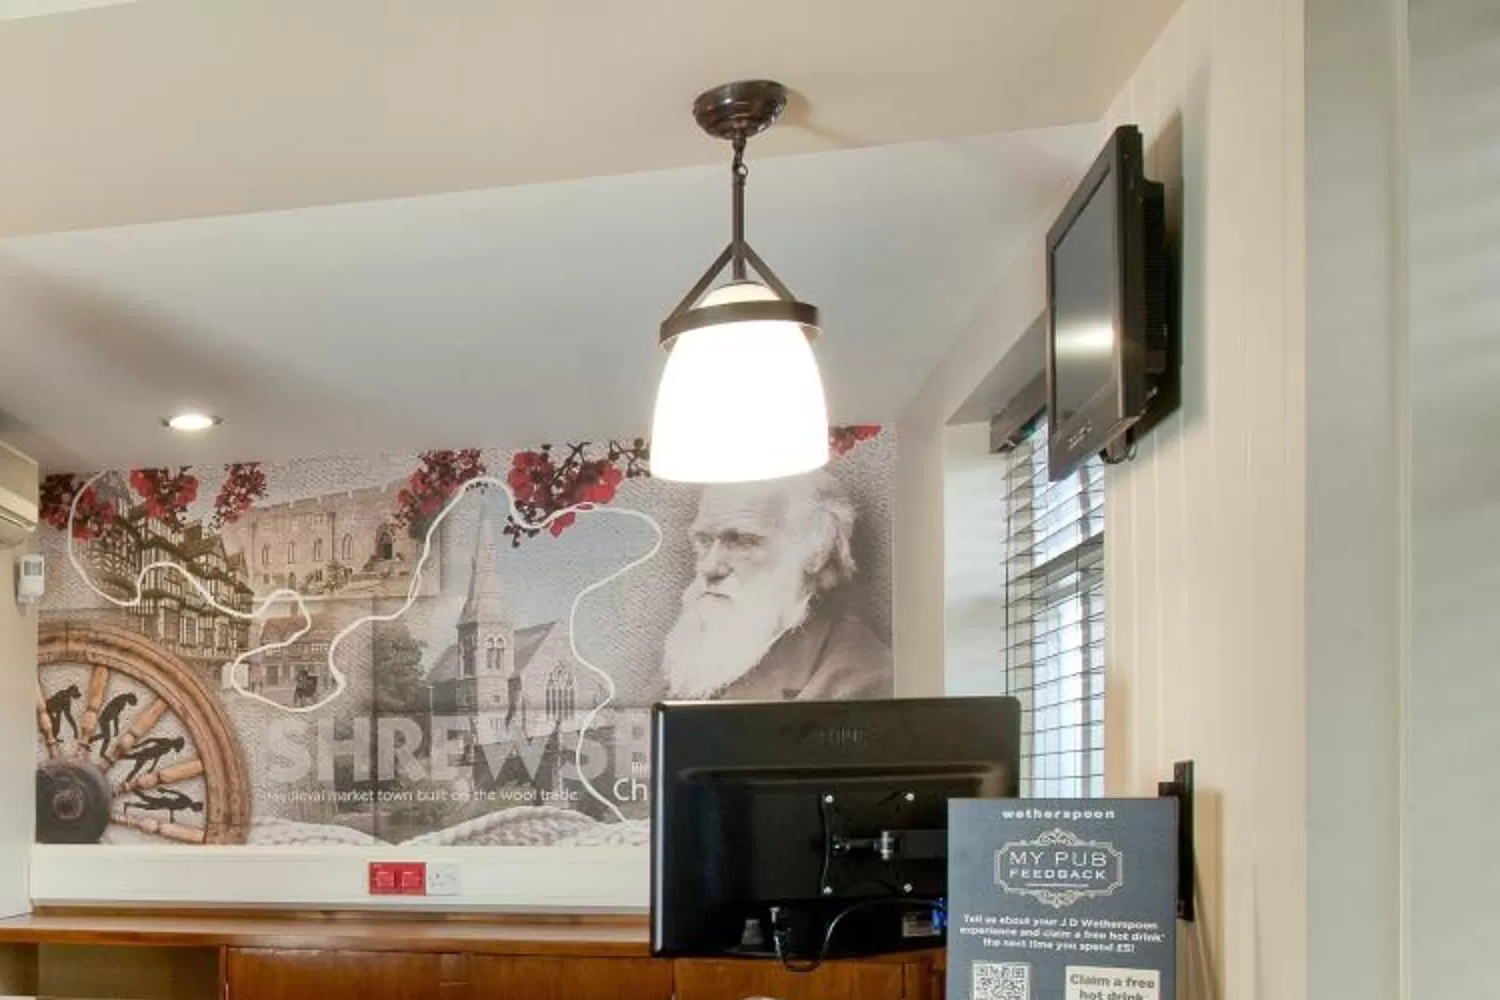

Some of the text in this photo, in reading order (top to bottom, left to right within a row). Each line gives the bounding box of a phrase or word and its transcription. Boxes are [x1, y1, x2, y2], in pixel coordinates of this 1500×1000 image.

[329, 788, 374, 801] market
[377, 790, 413, 801] town
[417, 789, 446, 801] built
[474, 790, 497, 801] the
[501, 789, 536, 801] wool
[540, 788, 578, 801] trade
[1002, 809, 1116, 821] wetherspoon
[1009, 852, 1108, 867] MY PUB
[1009, 868, 1106, 880] FEEDBACK
[963, 913, 983, 924] Tell
[1000, 916, 1030, 925] about
[1032, 918, 1058, 928] your
[1069, 918, 1078, 927] D
[1080, 919, 1159, 931] Wetherspoon
[959, 926, 1018, 936] experience
[1020, 928, 1040, 937] and
[1109, 931, 1130, 941] hot
[1029, 939, 1053, 949] time
[1055, 941, 1078, 952] you
[1070, 974, 1156, 989] Claim a free
[1079, 989, 1104, 1000] hot
